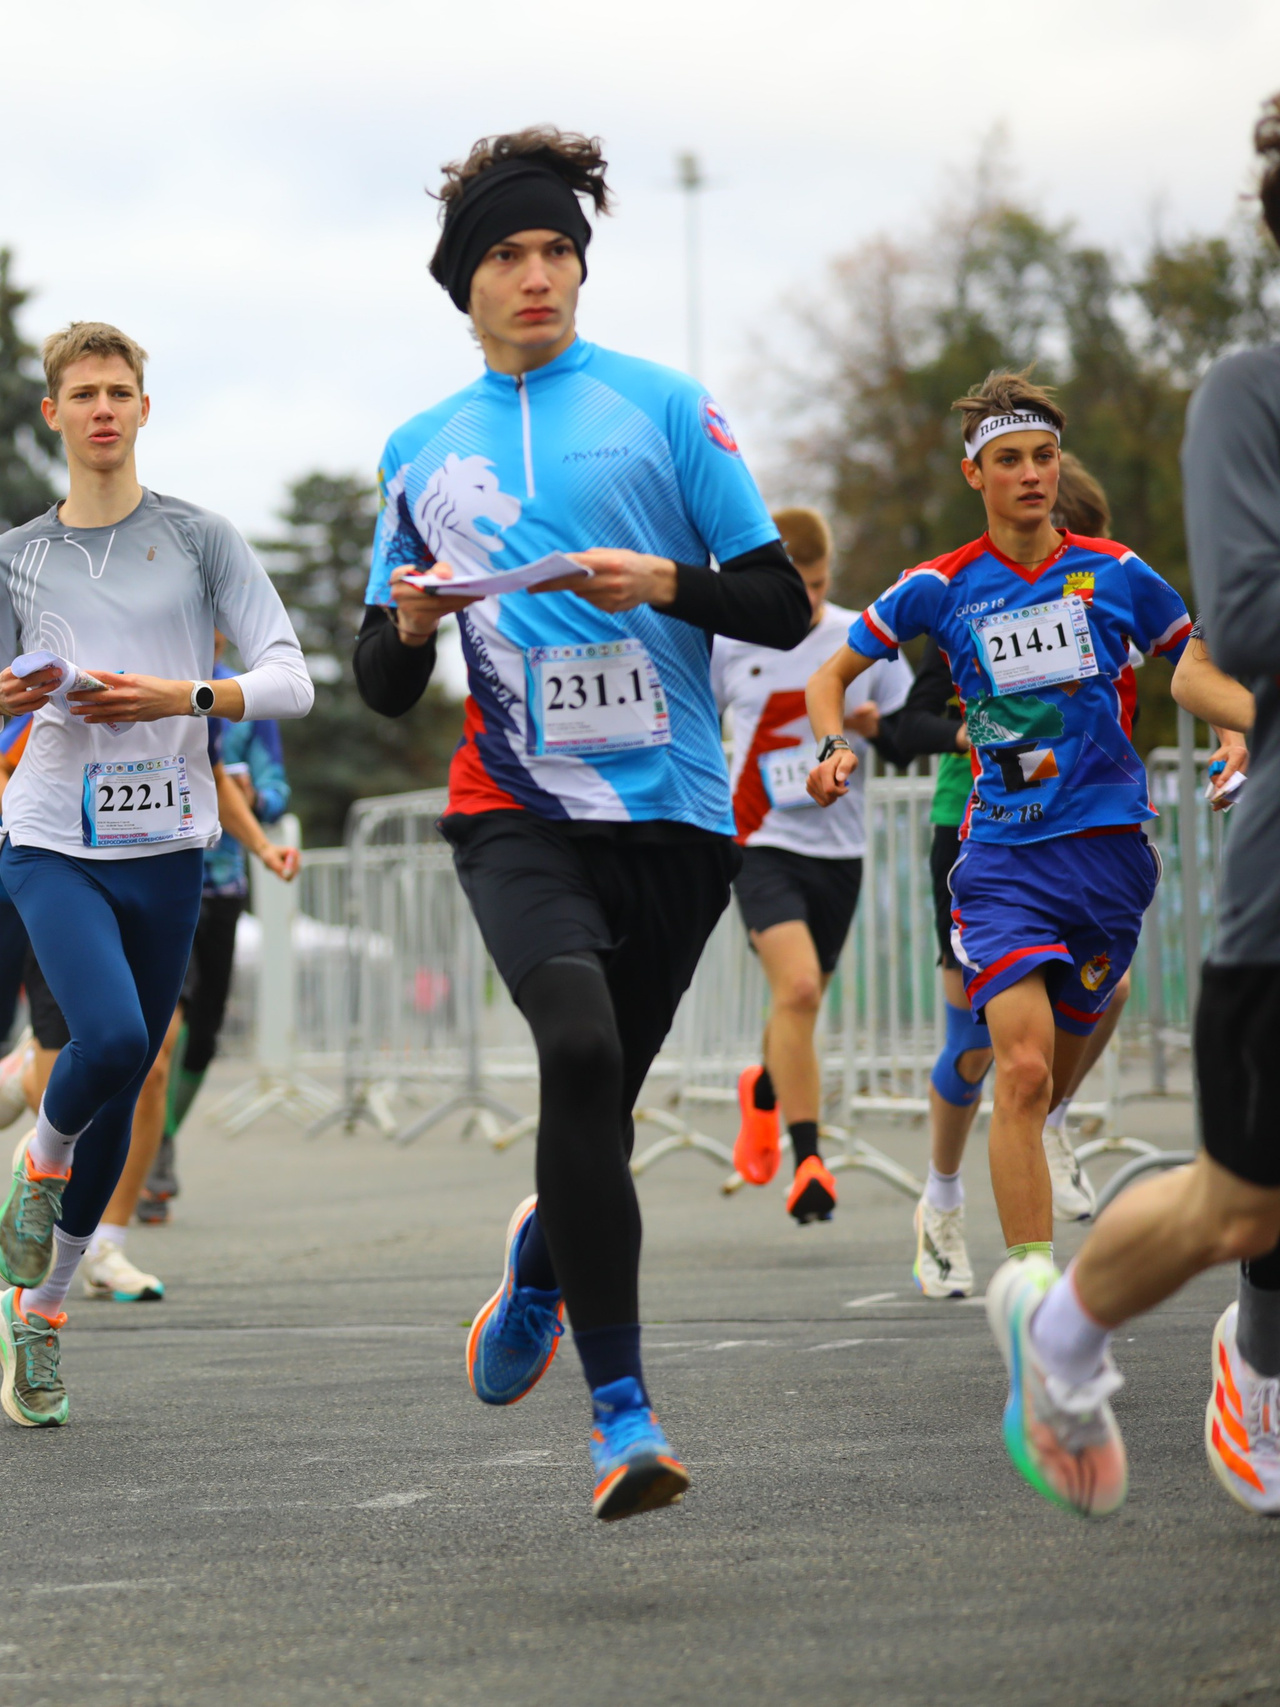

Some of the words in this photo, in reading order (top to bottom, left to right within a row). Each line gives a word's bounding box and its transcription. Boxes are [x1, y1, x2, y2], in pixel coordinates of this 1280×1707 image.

[991, 597, 1005, 609] 18
[988, 622, 1070, 662] 214.1
[545, 668, 646, 711] 231.1
[97, 780, 176, 812] 222.1
[1017, 802, 1044, 824] 18
